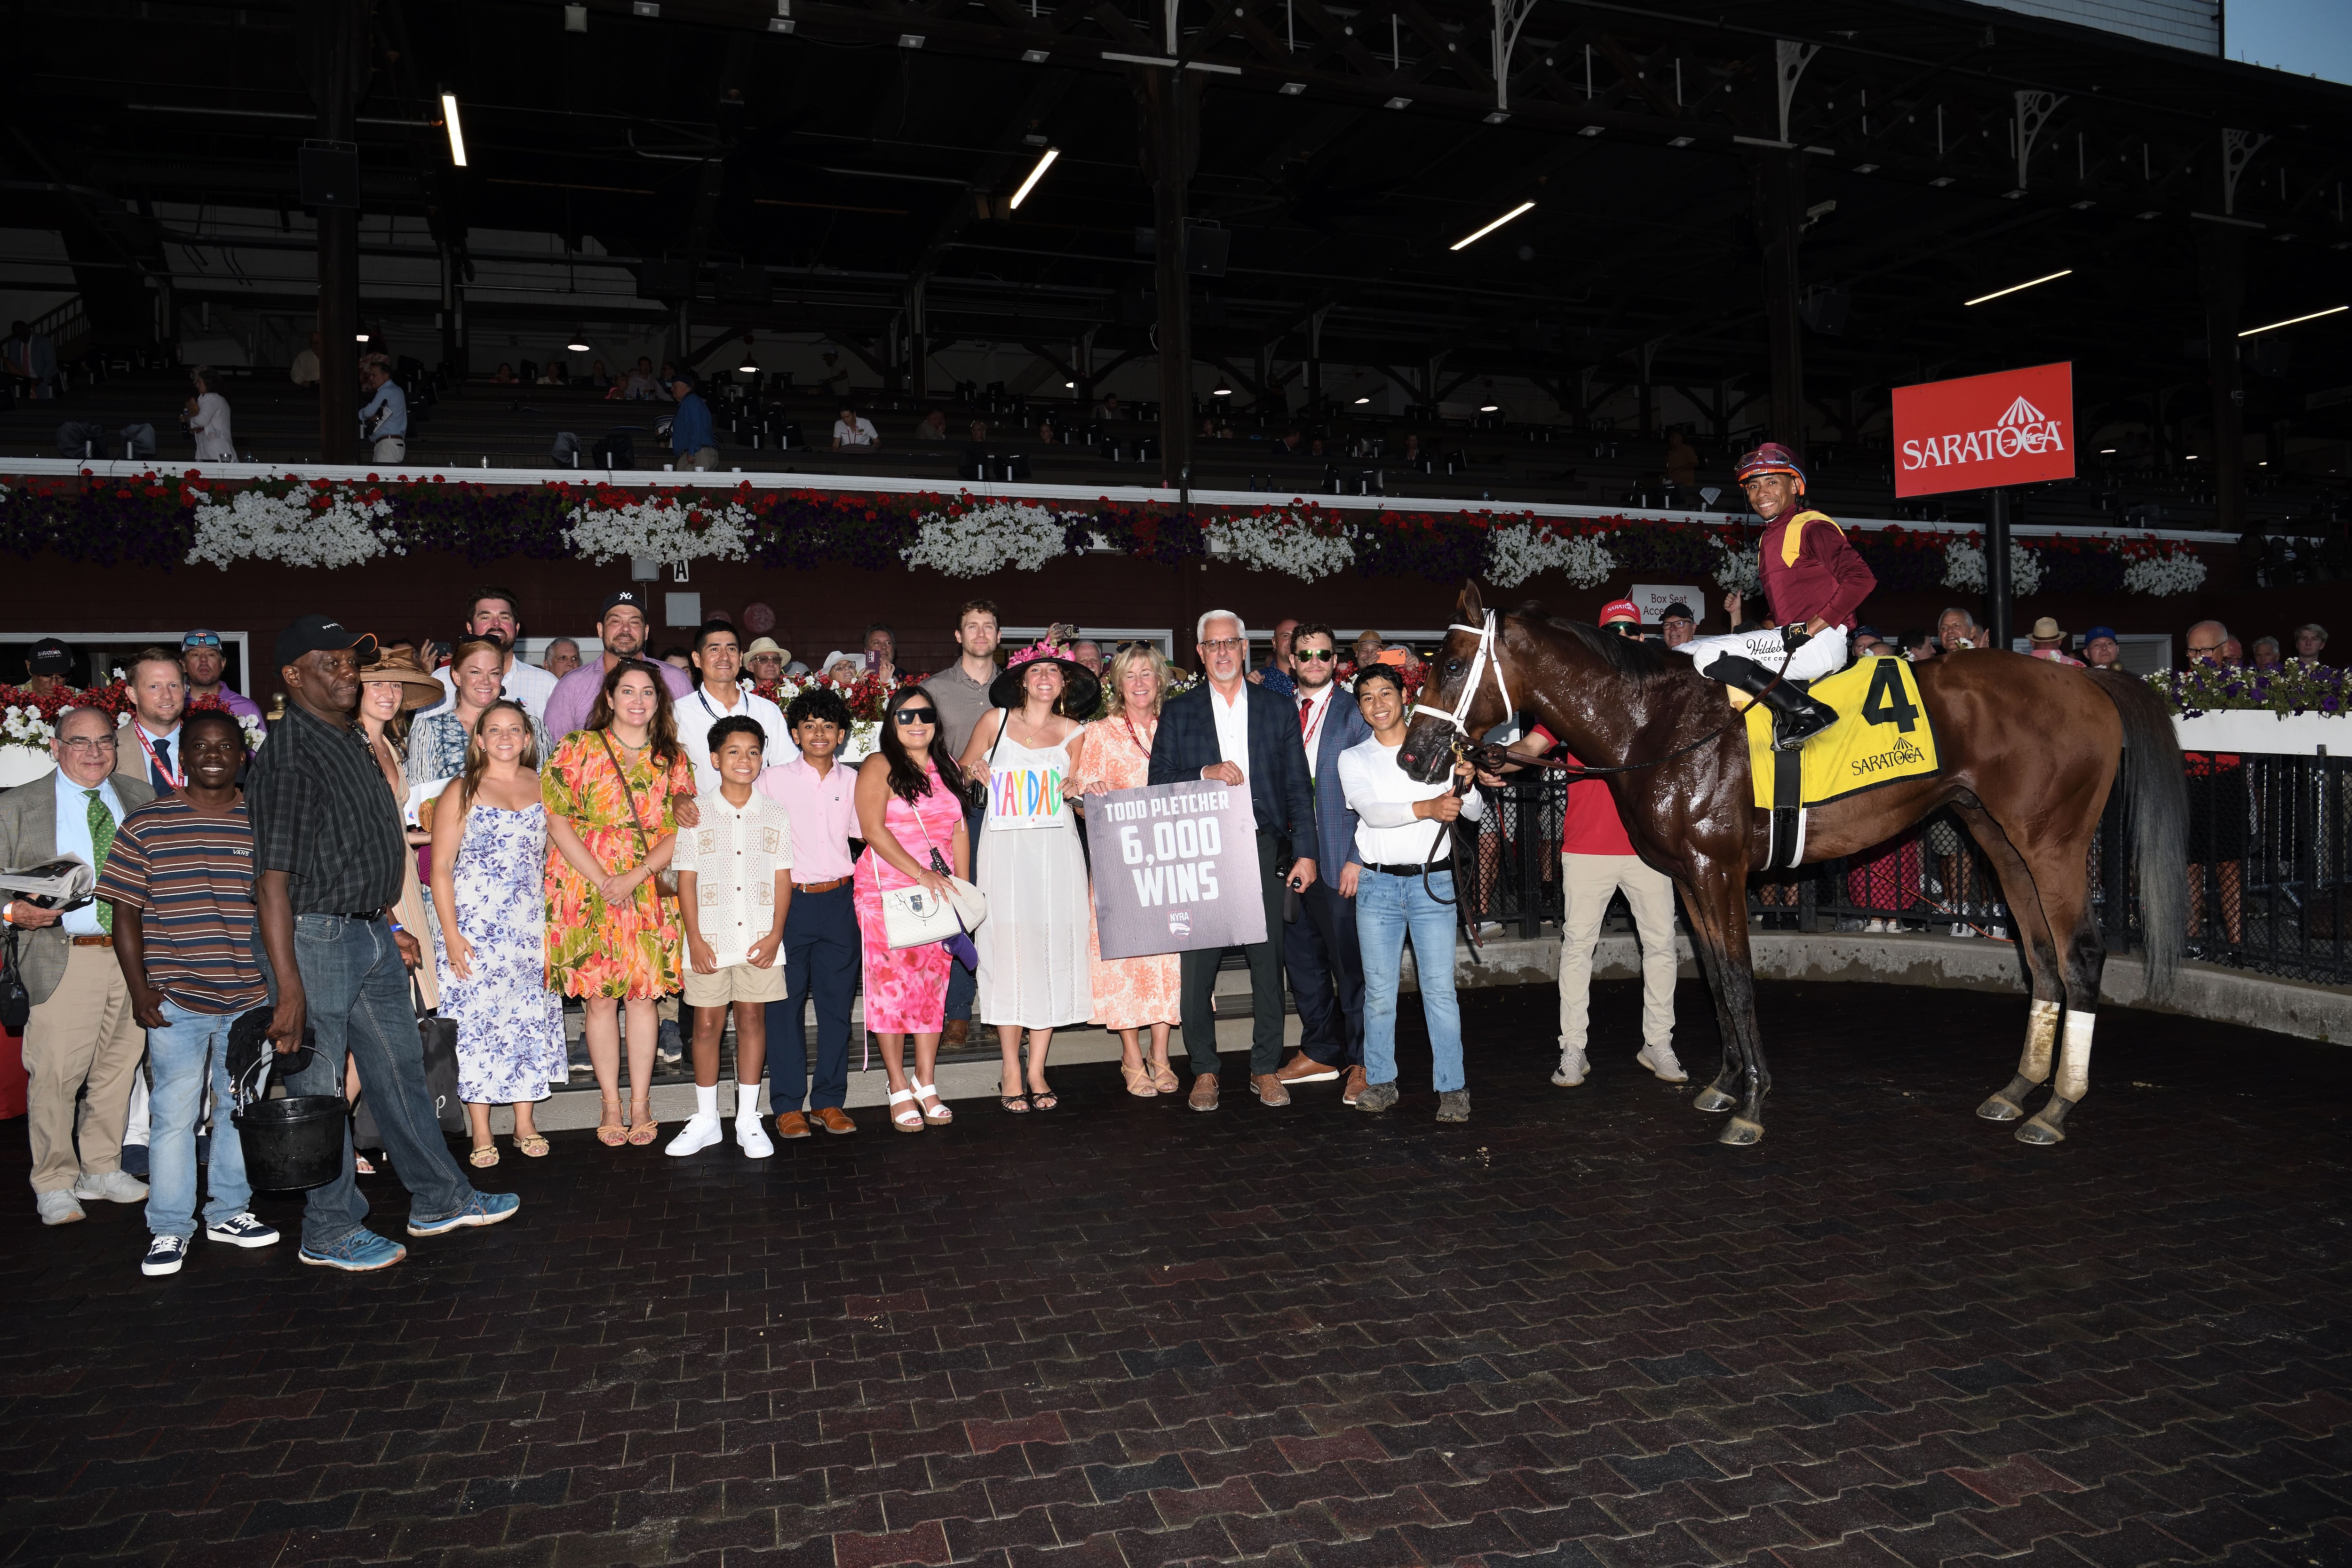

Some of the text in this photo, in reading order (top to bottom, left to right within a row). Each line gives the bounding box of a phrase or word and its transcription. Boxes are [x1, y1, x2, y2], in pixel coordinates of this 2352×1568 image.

[1903, 421, 2065, 470] SARATOGA
[675, 561, 687, 579] A
[1607, 605, 1636, 613] SARATOGA
[1651, 594, 1687, 604] Box Seat
[1861, 658, 1919, 733] 4
[361, 733, 371, 744] NYRA
[1851, 747, 1925, 776] SARATOGA
[160, 767, 175, 786] WHITNEY
[991, 769, 1062, 817] YAY DAD
[1104, 790, 1230, 822] TODD PLETCHER
[1120, 817, 1222, 866] 6,000
[1132, 861, 1219, 907] WINS
[1170, 911, 1190, 922] NYRA
